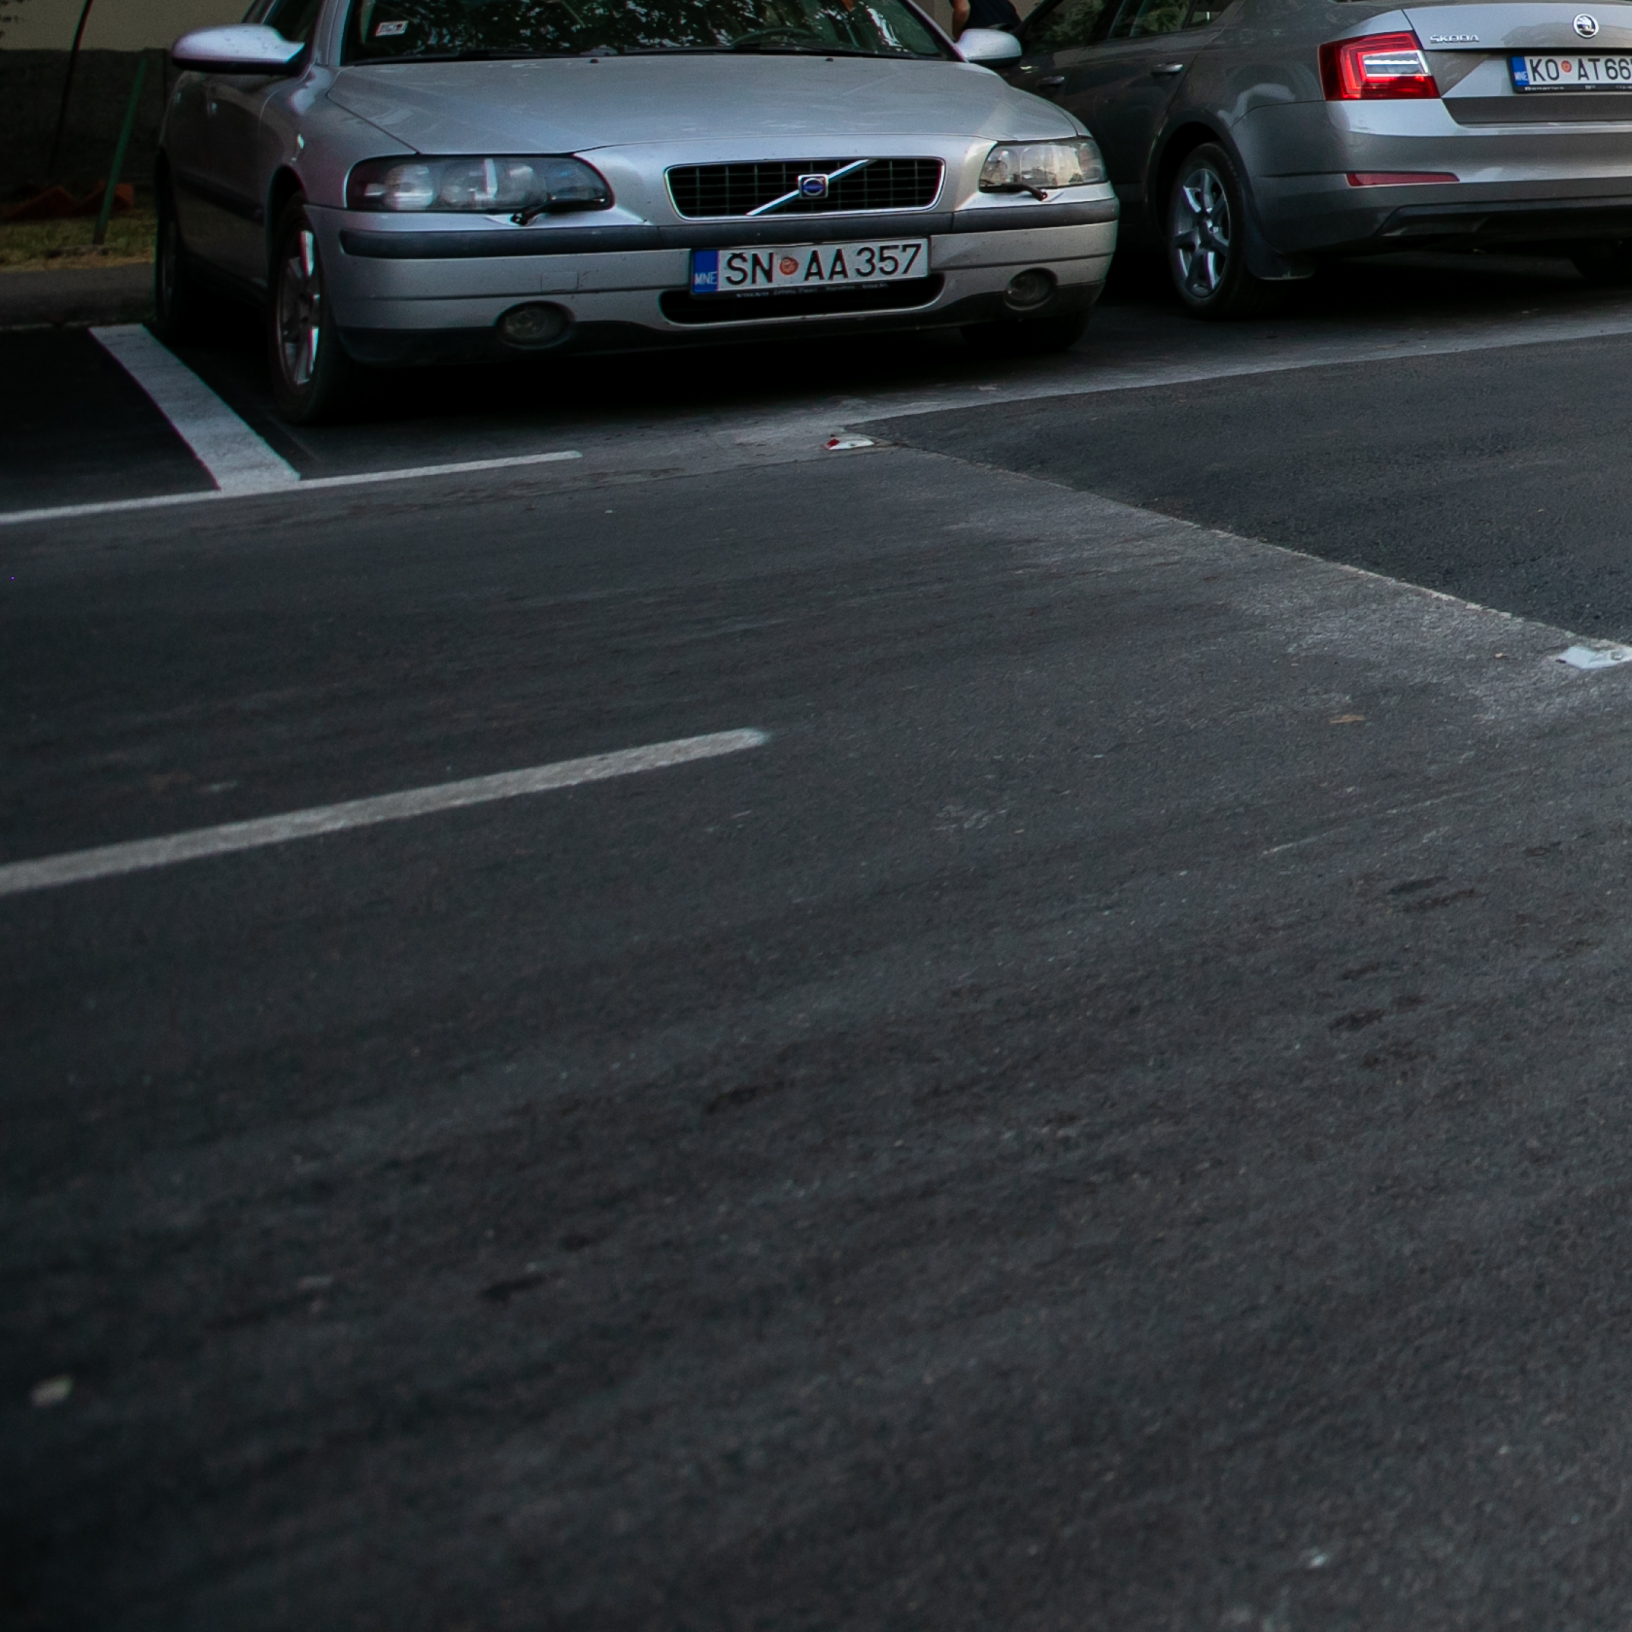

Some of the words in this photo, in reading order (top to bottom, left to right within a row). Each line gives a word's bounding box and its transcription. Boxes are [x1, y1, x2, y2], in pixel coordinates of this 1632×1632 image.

[1529, 58, 1560, 82] KO
[804, 243, 922, 281] AA357
[694, 271, 717, 285] MNE
